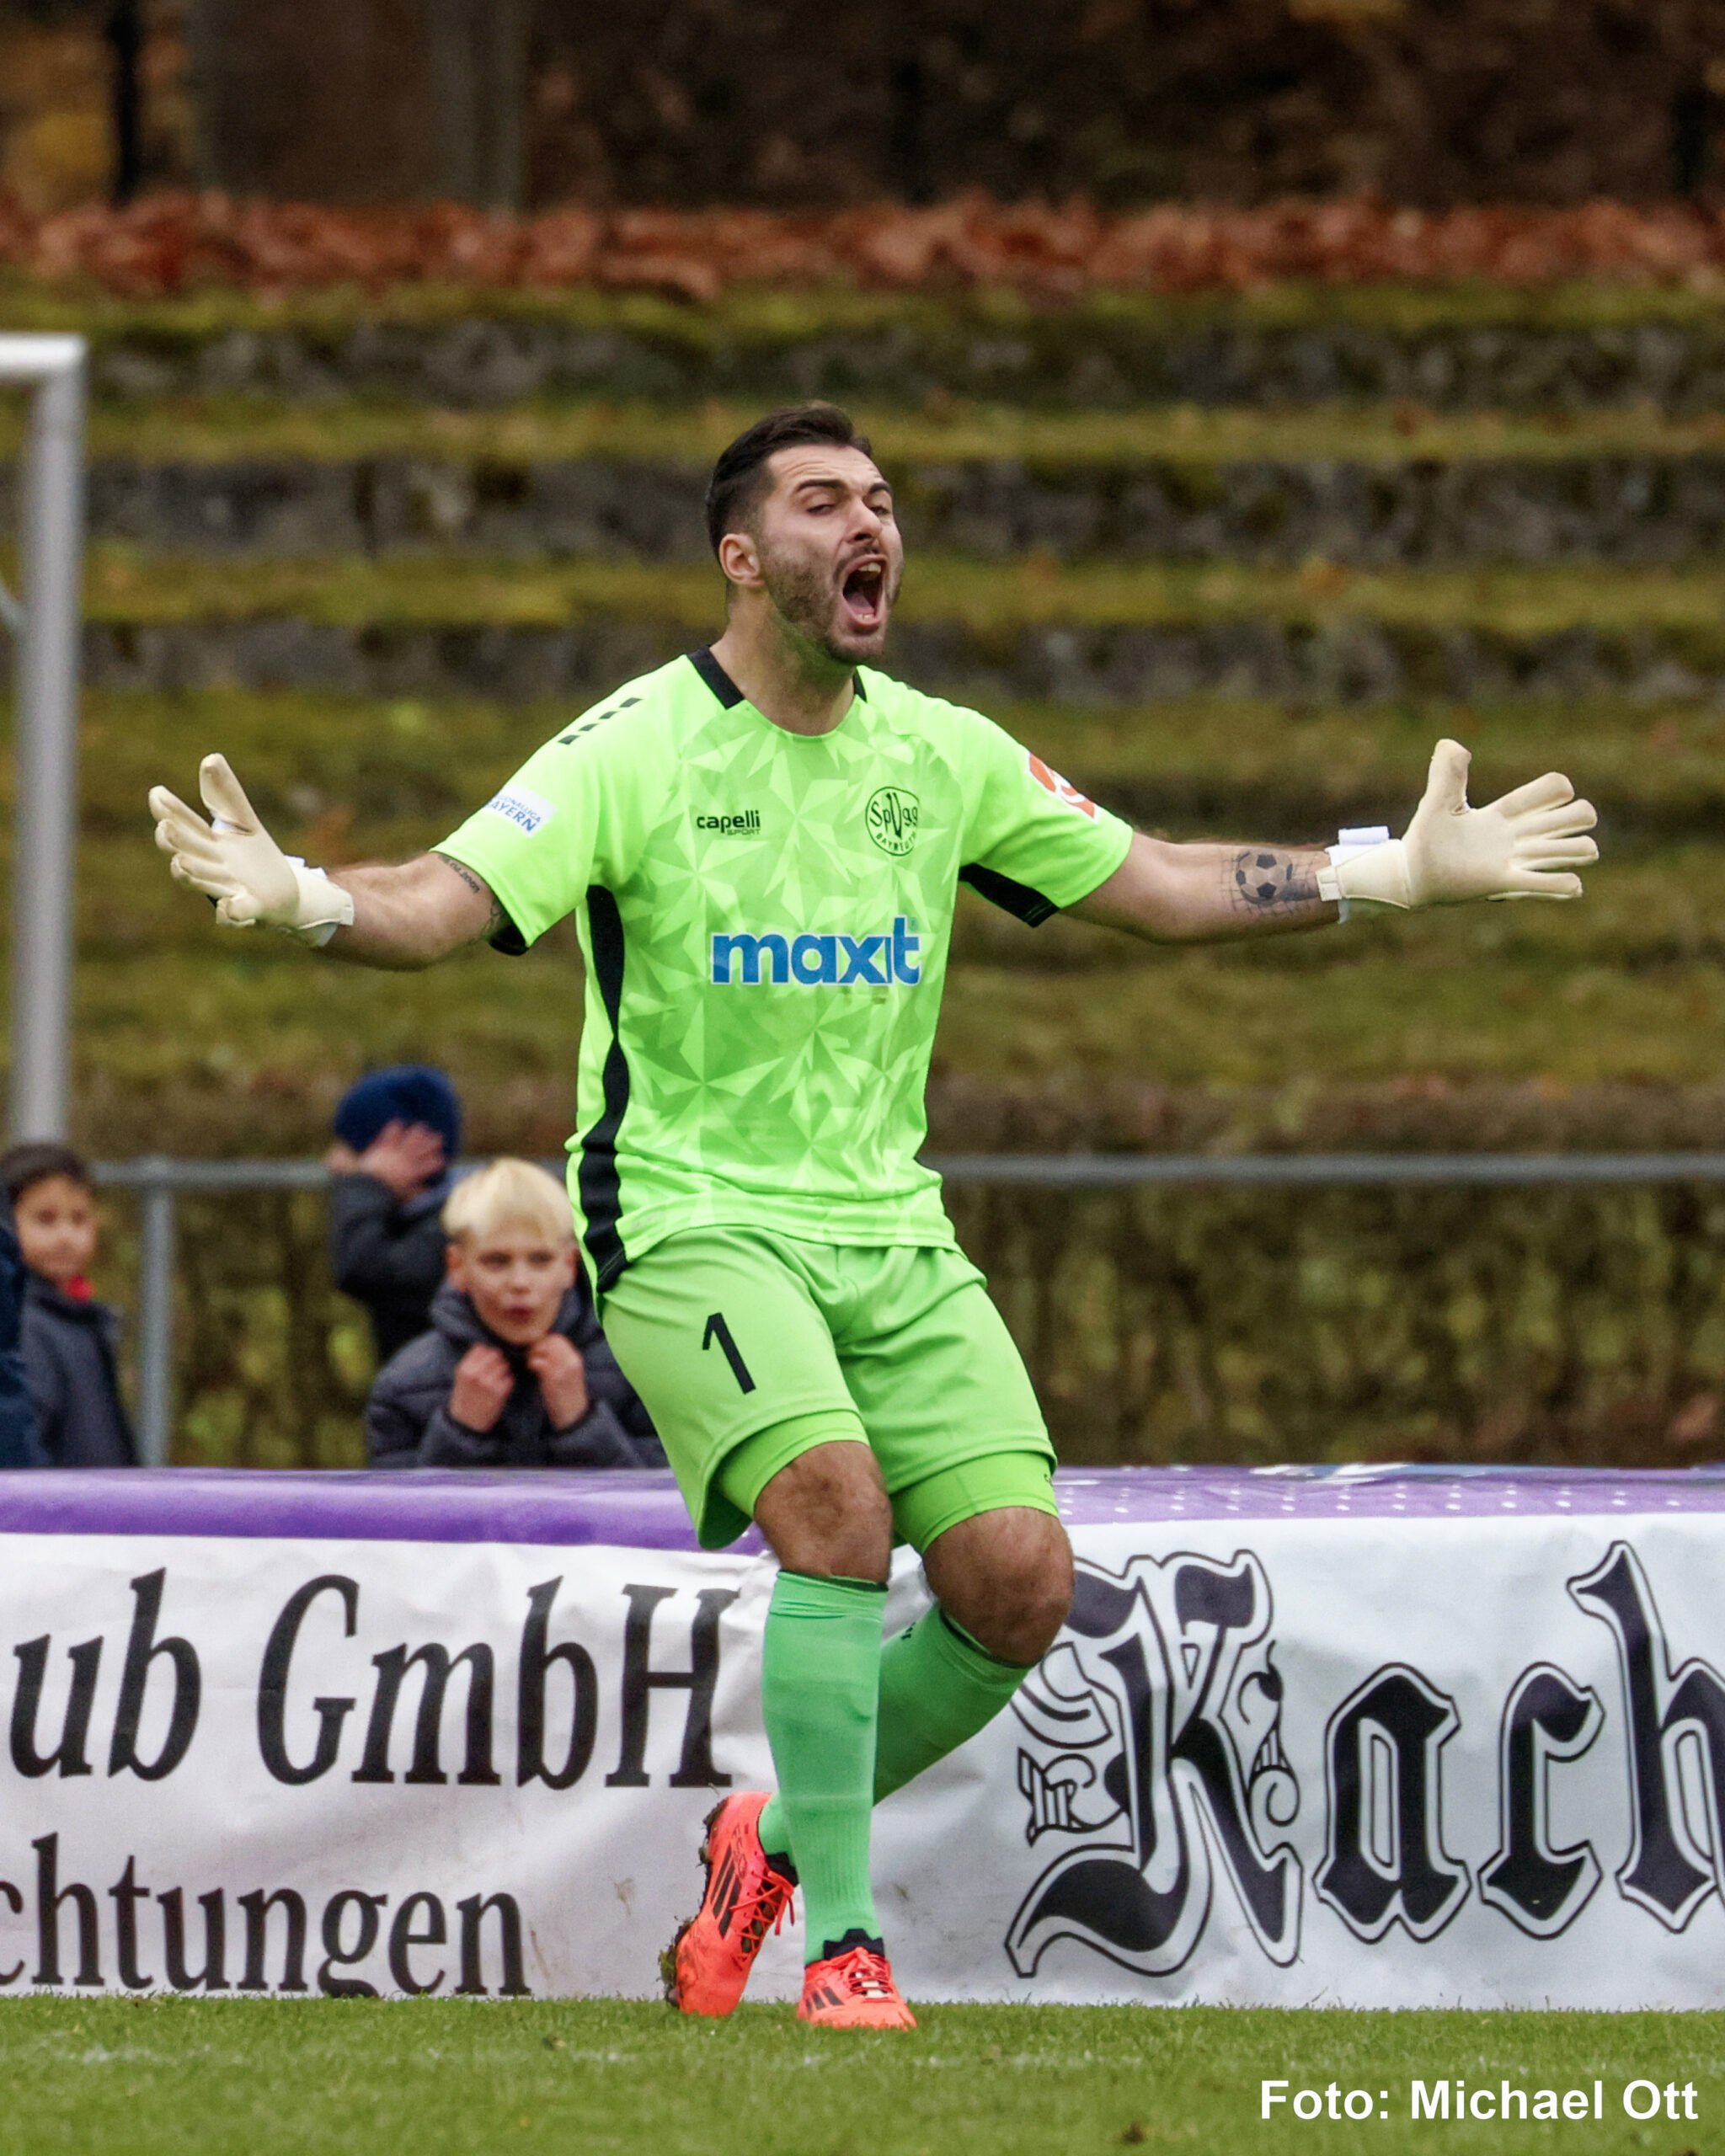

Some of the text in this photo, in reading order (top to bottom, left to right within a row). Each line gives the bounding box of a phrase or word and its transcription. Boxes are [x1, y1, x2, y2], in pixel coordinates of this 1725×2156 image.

[488, 800, 537, 832] AYERN
[697, 809, 761, 834] capelli
[726, 828, 761, 836] SPORT
[711, 915, 921, 987] maxit
[702, 1312, 756, 1396] 1
[9, 1566, 741, 1791] ub GmbH
[1004, 1540, 1725, 1977] Kach
